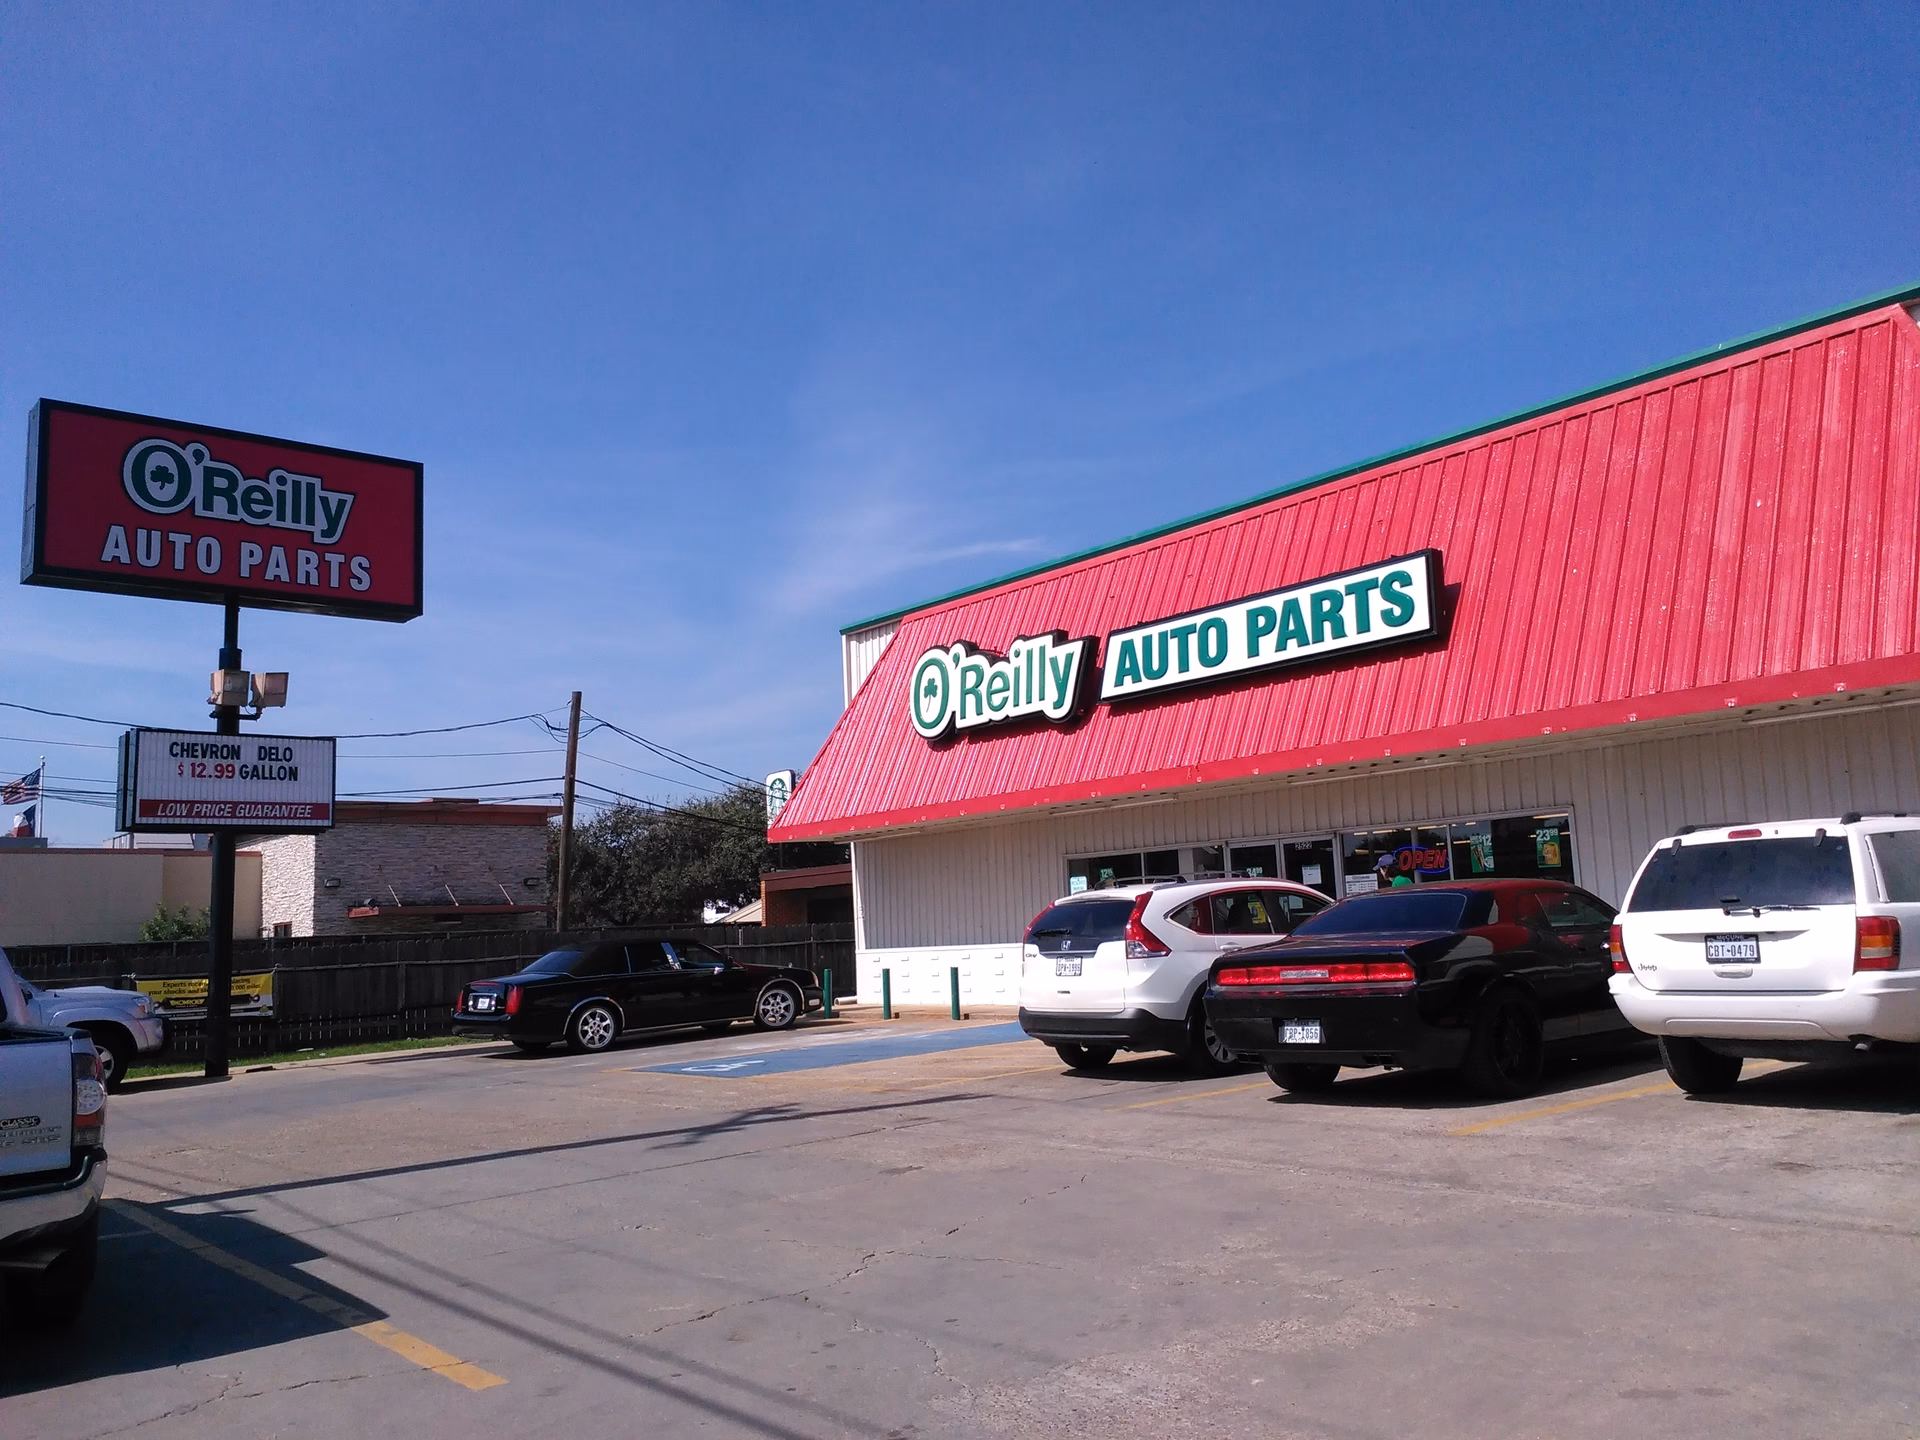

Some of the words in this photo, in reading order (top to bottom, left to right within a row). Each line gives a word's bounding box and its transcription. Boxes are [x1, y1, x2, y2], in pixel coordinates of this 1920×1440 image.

[129, 443, 348, 539] O'Reilly
[101, 523, 222, 574] AUTO
[240, 541, 372, 592] PARTS
[914, 642, 1077, 731] O'Reilly
[1114, 616, 1229, 687] AUTO
[1246, 570, 1416, 660] PARTS
[169, 742, 241, 760] CHEVRON
[258, 746, 293, 762] DELO
[239, 764, 299, 781] GALLON
[157, 803, 191, 817] LOW
[192, 803, 232, 817] PRICE
[236, 804, 313, 818] GUARANTEE
[1399, 849, 1446, 871] OPEN
[1638, 963, 1657, 972] Jeep
[163, 981, 186, 989] Experts
[0, 1116, 38, 1128] CLASSIC
